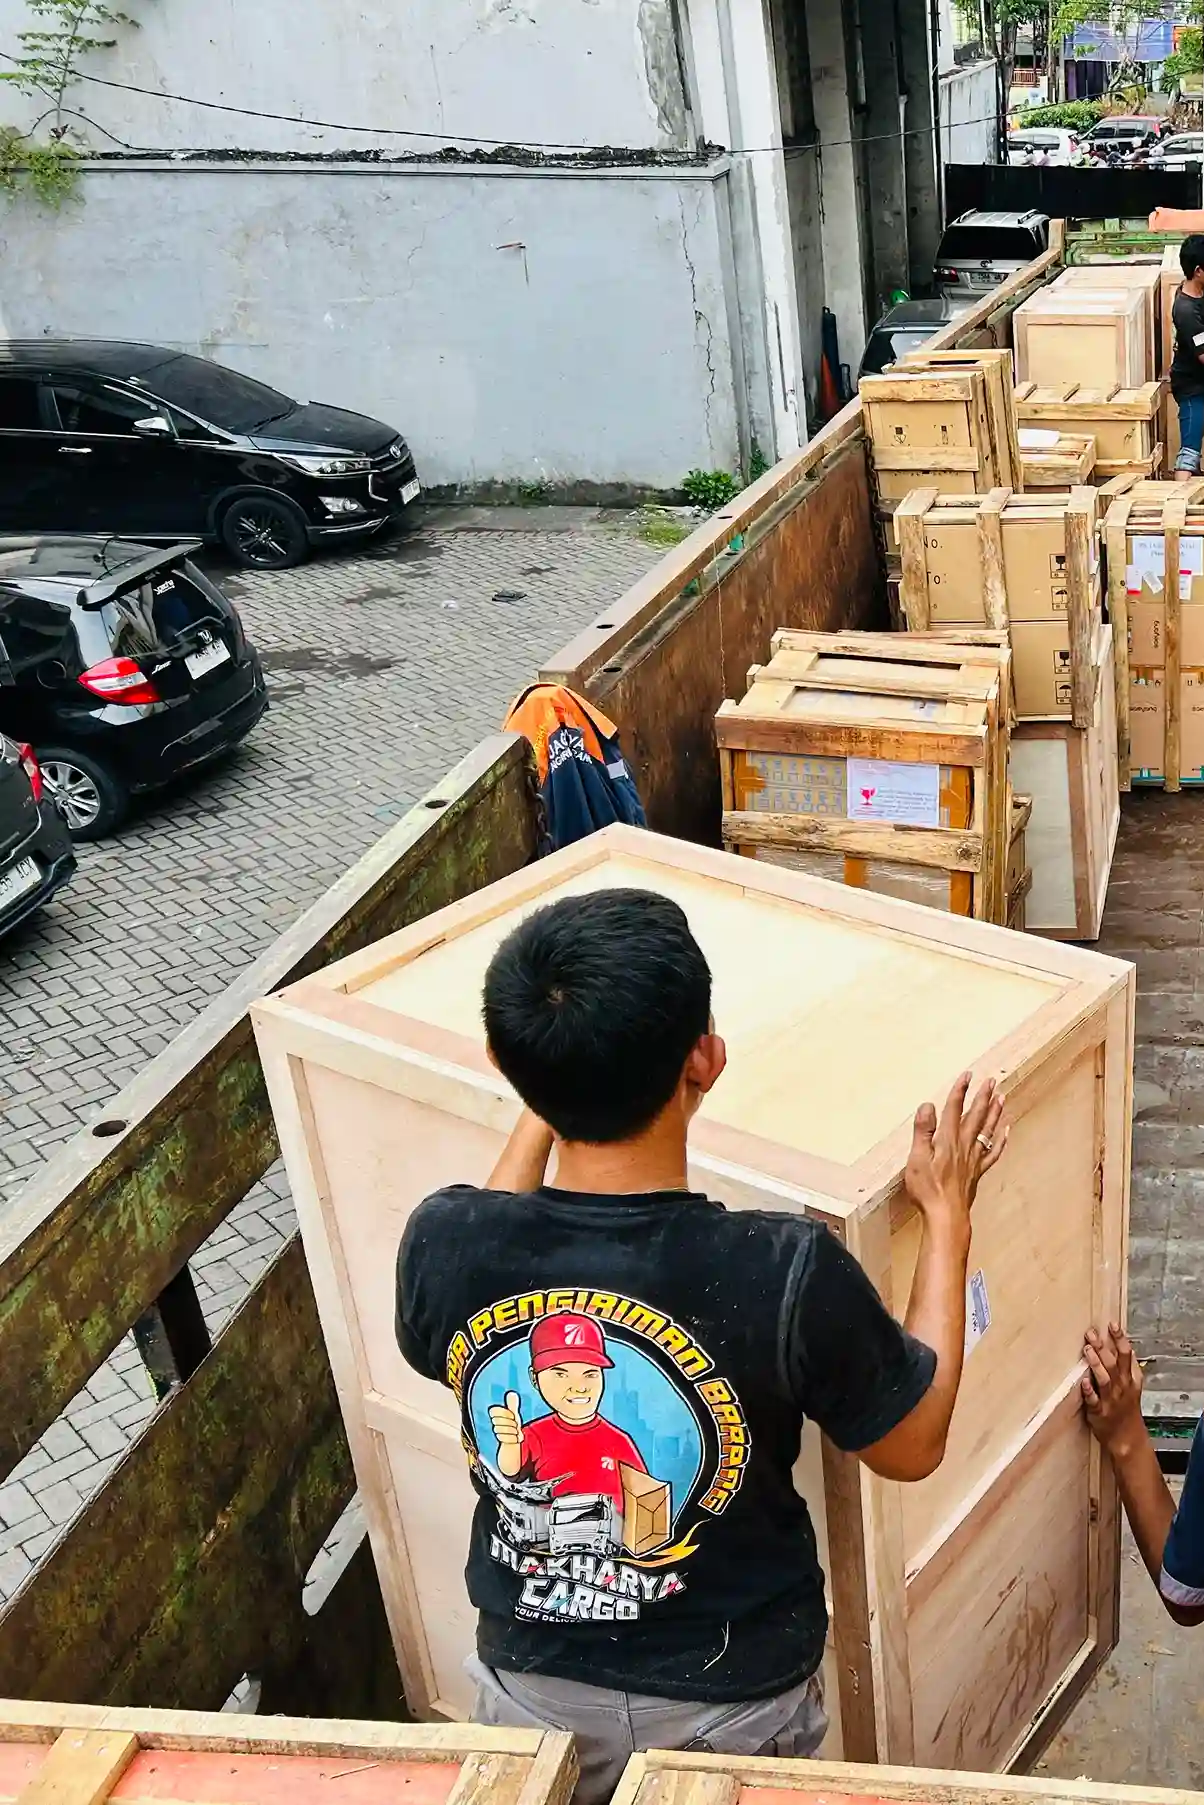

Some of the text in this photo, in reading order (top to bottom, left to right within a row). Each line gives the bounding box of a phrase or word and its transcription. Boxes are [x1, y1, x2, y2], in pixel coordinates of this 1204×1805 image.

[470, 1290, 713, 1378] PENGIRIMAN
[699, 1379, 749, 1514] BARANG
[490, 1534, 686, 1601] MAKHARYA
[515, 1606, 540, 1620] YOUR
[519, 1577, 640, 1621] CARGO
